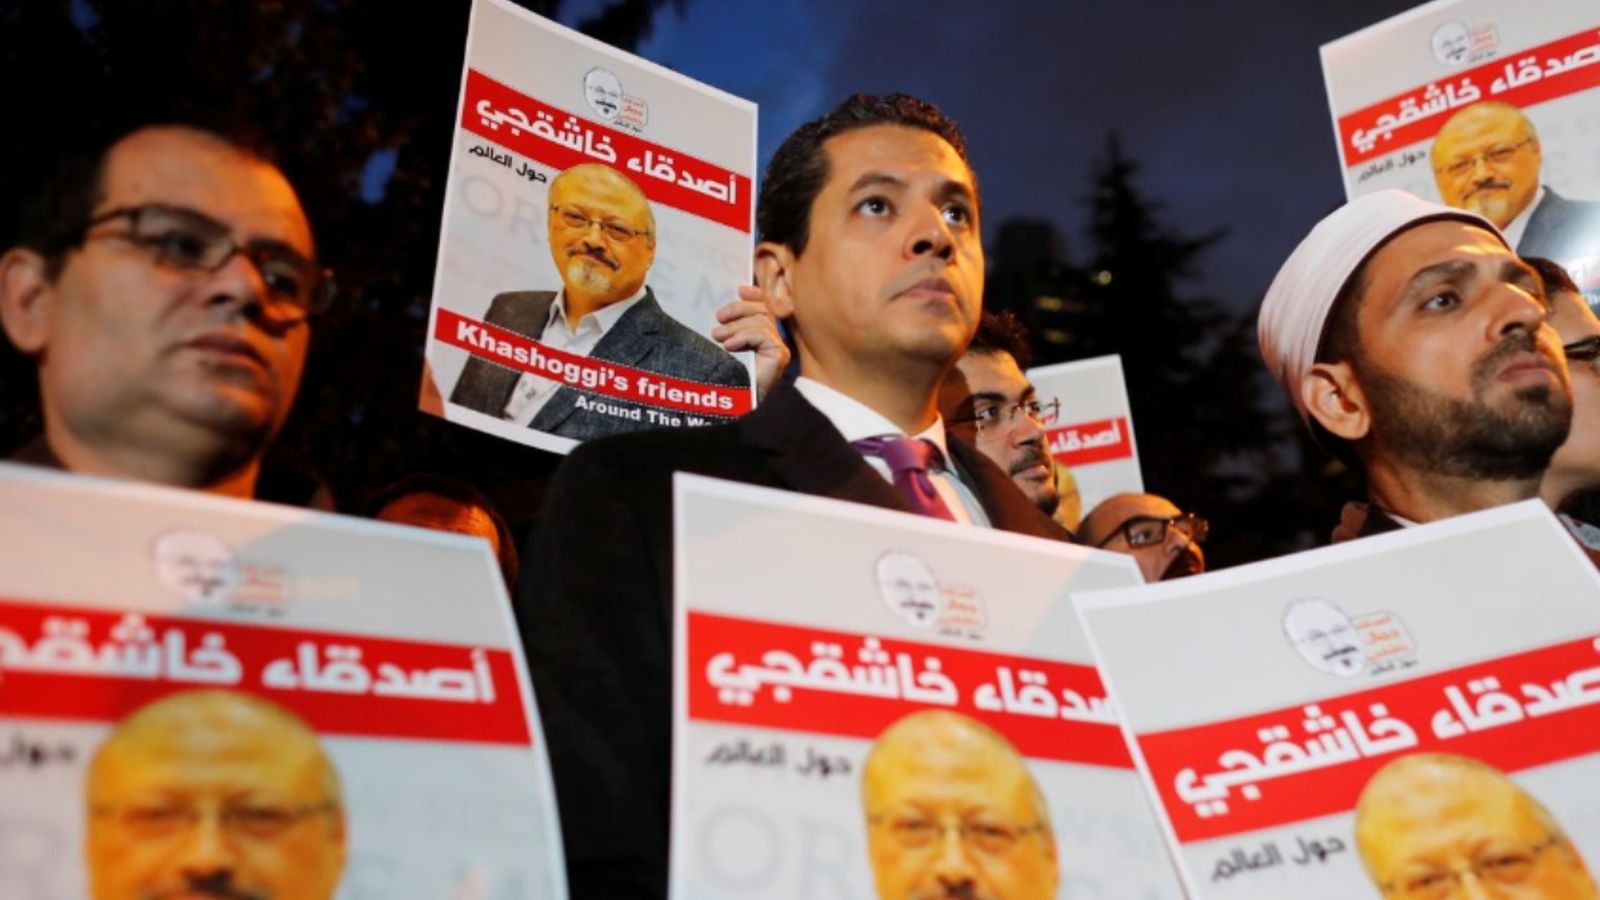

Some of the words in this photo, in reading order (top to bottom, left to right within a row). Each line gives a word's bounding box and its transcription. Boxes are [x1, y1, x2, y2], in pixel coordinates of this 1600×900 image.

[476, 98, 617, 164] خاشقجي
[1351, 78, 1482, 154] خاشقجي
[515, 161, 548, 184] حول
[626, 149, 737, 205] أصدقاء
[574, 395, 641, 421] Around
[646, 410, 682, 427] The
[636, 377, 734, 410] friends
[262, 642, 496, 703] أصدقاء
[705, 637, 960, 706] خاشقجي
[1173, 701, 1419, 818] خاشقجي
[1211, 843, 1283, 881] العالم
[1295, 835, 1346, 868] حول
